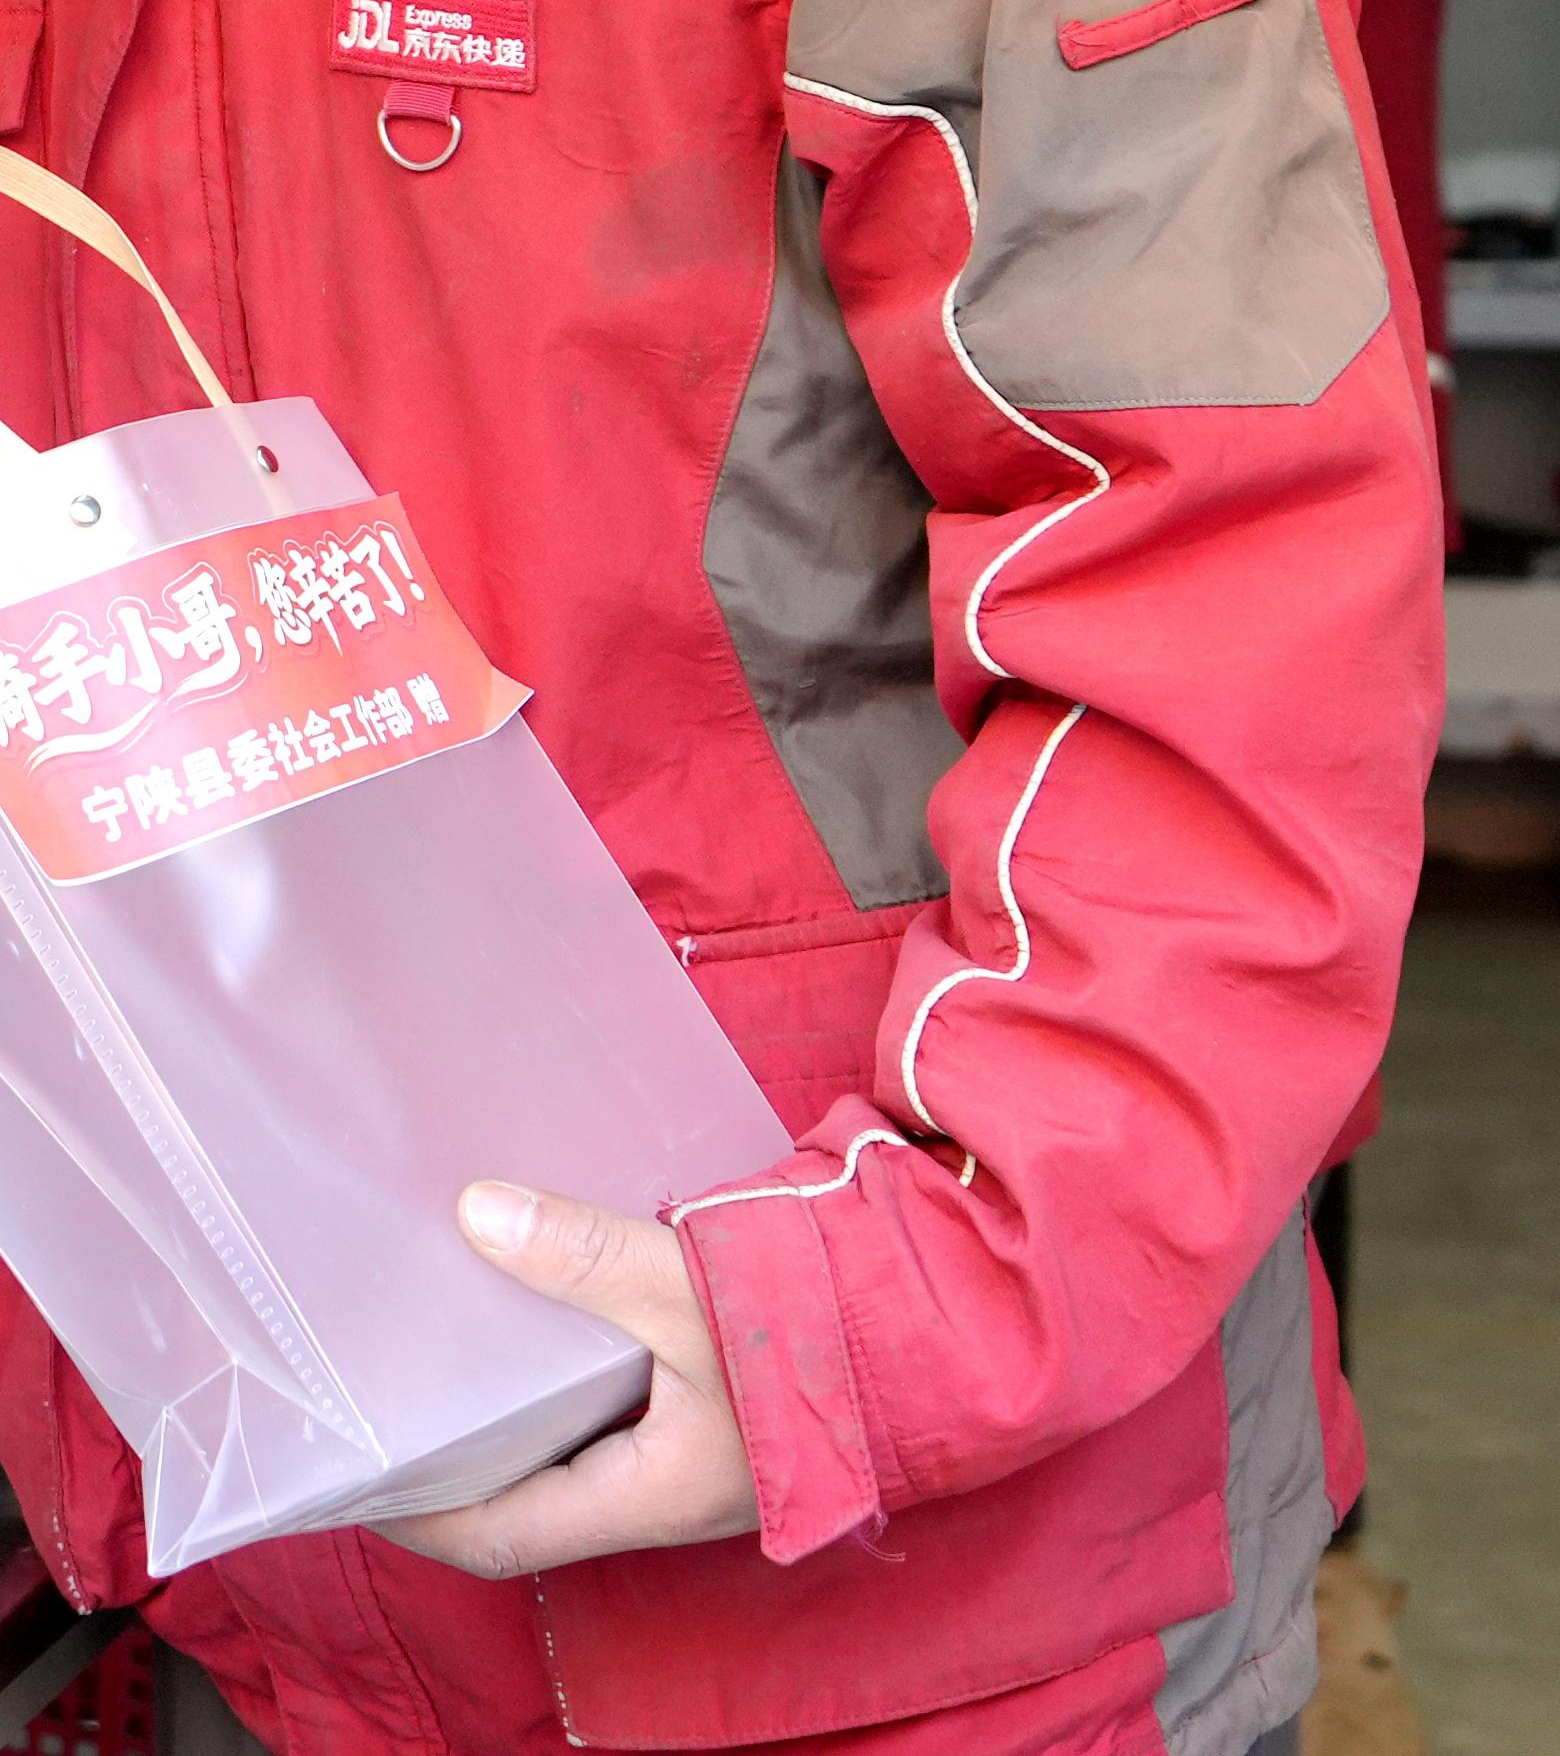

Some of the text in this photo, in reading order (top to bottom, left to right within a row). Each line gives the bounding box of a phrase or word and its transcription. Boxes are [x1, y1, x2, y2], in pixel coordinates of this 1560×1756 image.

[405, 4, 473, 30] Express
[402, 28, 526, 69] 京东快递
[80, 686, 414, 843] 宁陕县委社会工作部
